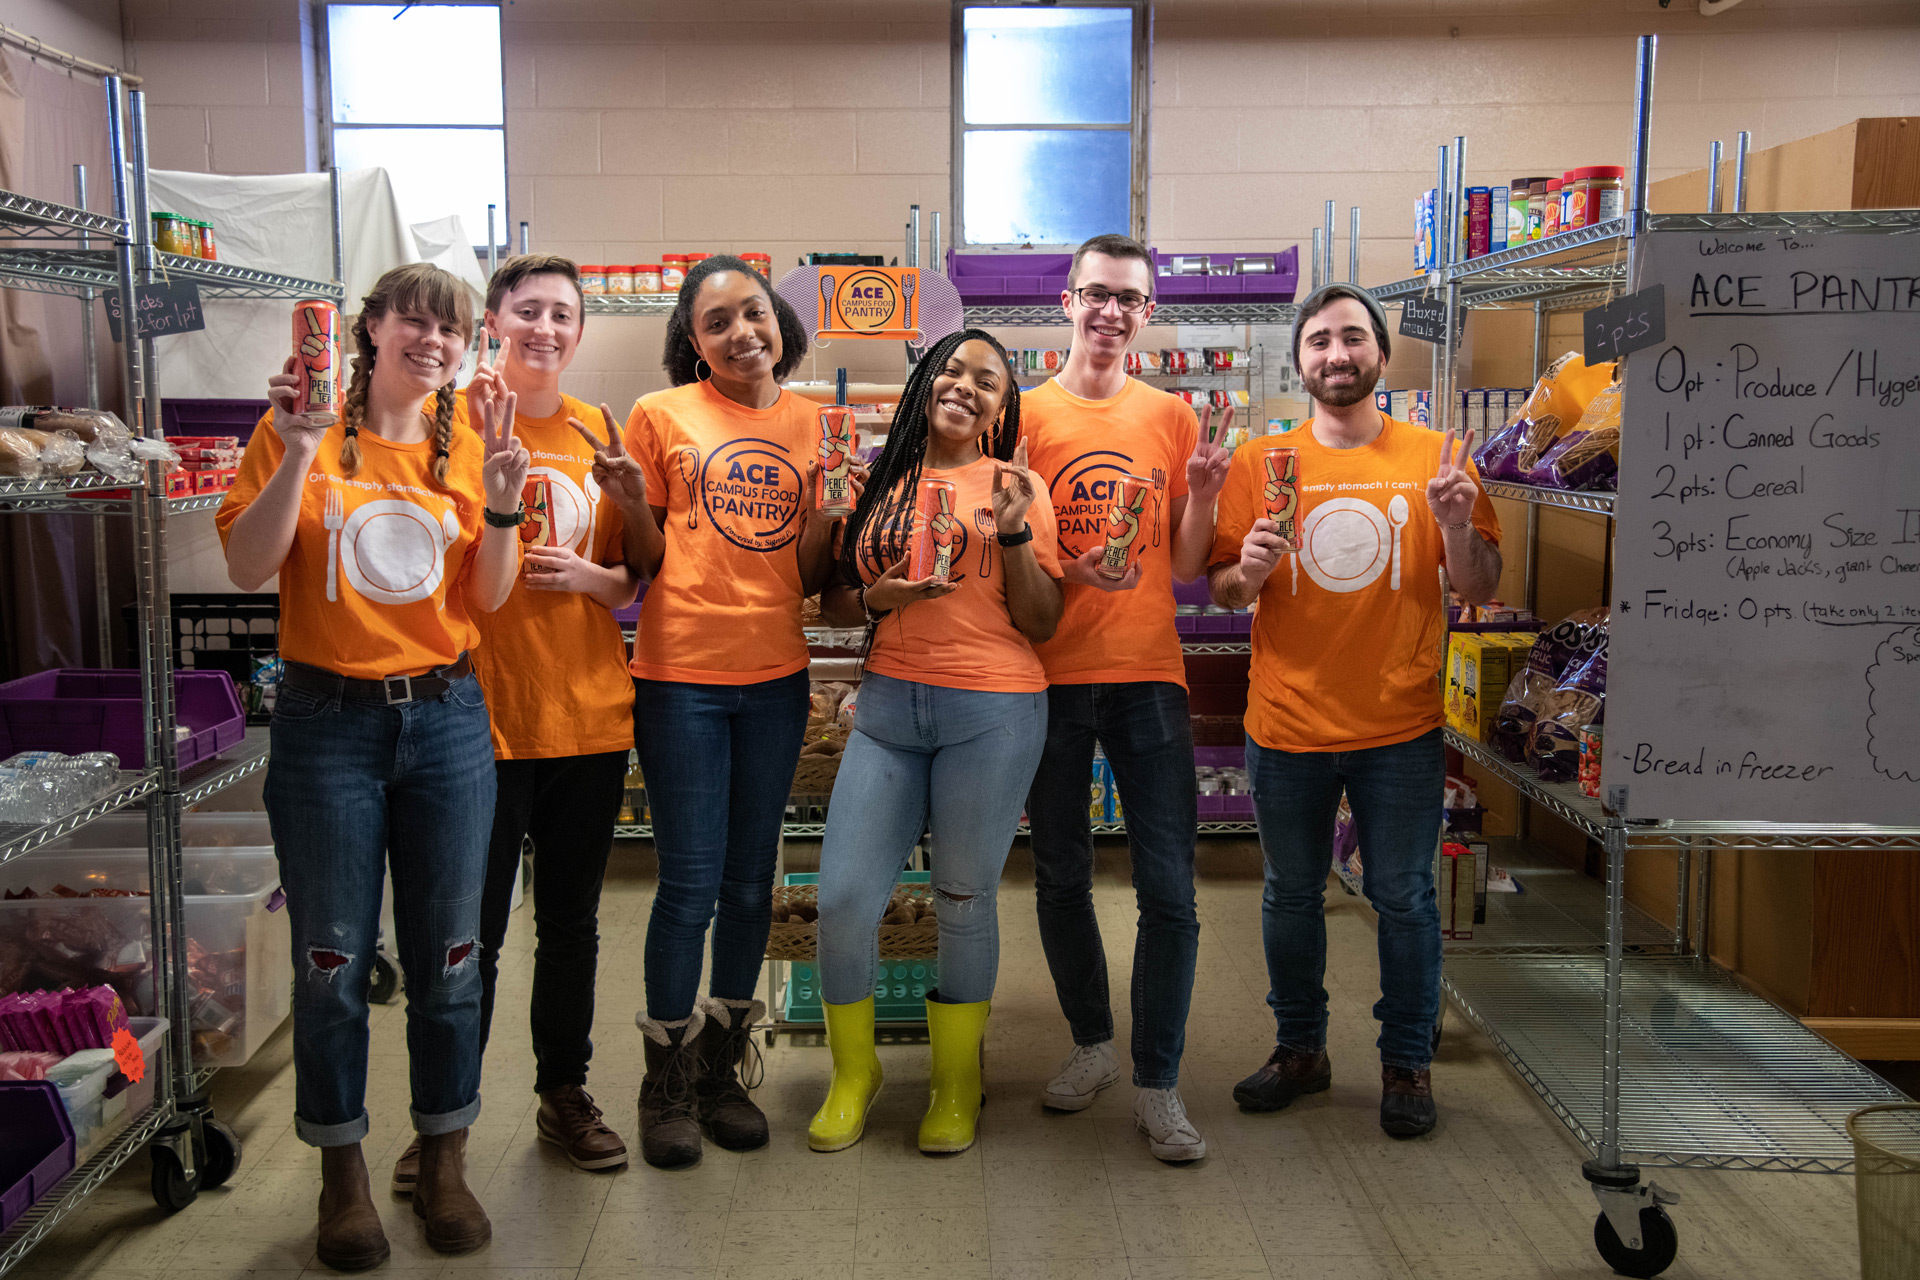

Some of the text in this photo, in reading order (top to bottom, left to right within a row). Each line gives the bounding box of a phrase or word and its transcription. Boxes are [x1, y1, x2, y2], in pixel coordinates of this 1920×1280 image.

[1700, 237, 1814, 256] Welcome To...
[851, 287, 884, 299] ACE
[1691, 273, 1766, 307] ACE
[845, 307, 891, 318] PANTRY
[873, 300, 894, 308] FOOD
[1407, 300, 1445, 322] Boxed
[147, 313, 173, 330] for
[1403, 322, 1434, 337] meals
[1730, 343, 1817, 400] Produce
[311, 380, 338, 394] PEAE
[1723, 413, 1794, 450] Canned
[1809, 413, 1881, 449] Goods
[532, 450, 575, 463] stomach
[726, 461, 780, 487] ACE
[825, 478, 847, 490] PEACE
[1726, 464, 1805, 500] Cereal
[309, 472, 326, 483] On
[328, 474, 343, 484] an
[346, 479, 383, 492] empty
[386, 482, 434, 498] stomach
[706, 480, 798, 503] CAMPUS FOOD
[1302, 483, 1336, 492] empty
[1337, 481, 1383, 491] stomach
[1385, 481, 1389, 489] I
[712, 495, 791, 521] PANTRY
[764, 535, 786, 547] Sigma
[1725, 514, 1813, 558] Economy
[1823, 512, 1879, 549] Size
[1103, 544, 1128, 560] PEACE
[1835, 561, 1873, 584] giant
[1849, 605, 1879, 625] only
[1884, 605, 1896, 617] 2
[1716, 759, 1732, 775] in
[1737, 751, 1834, 782] freezer
